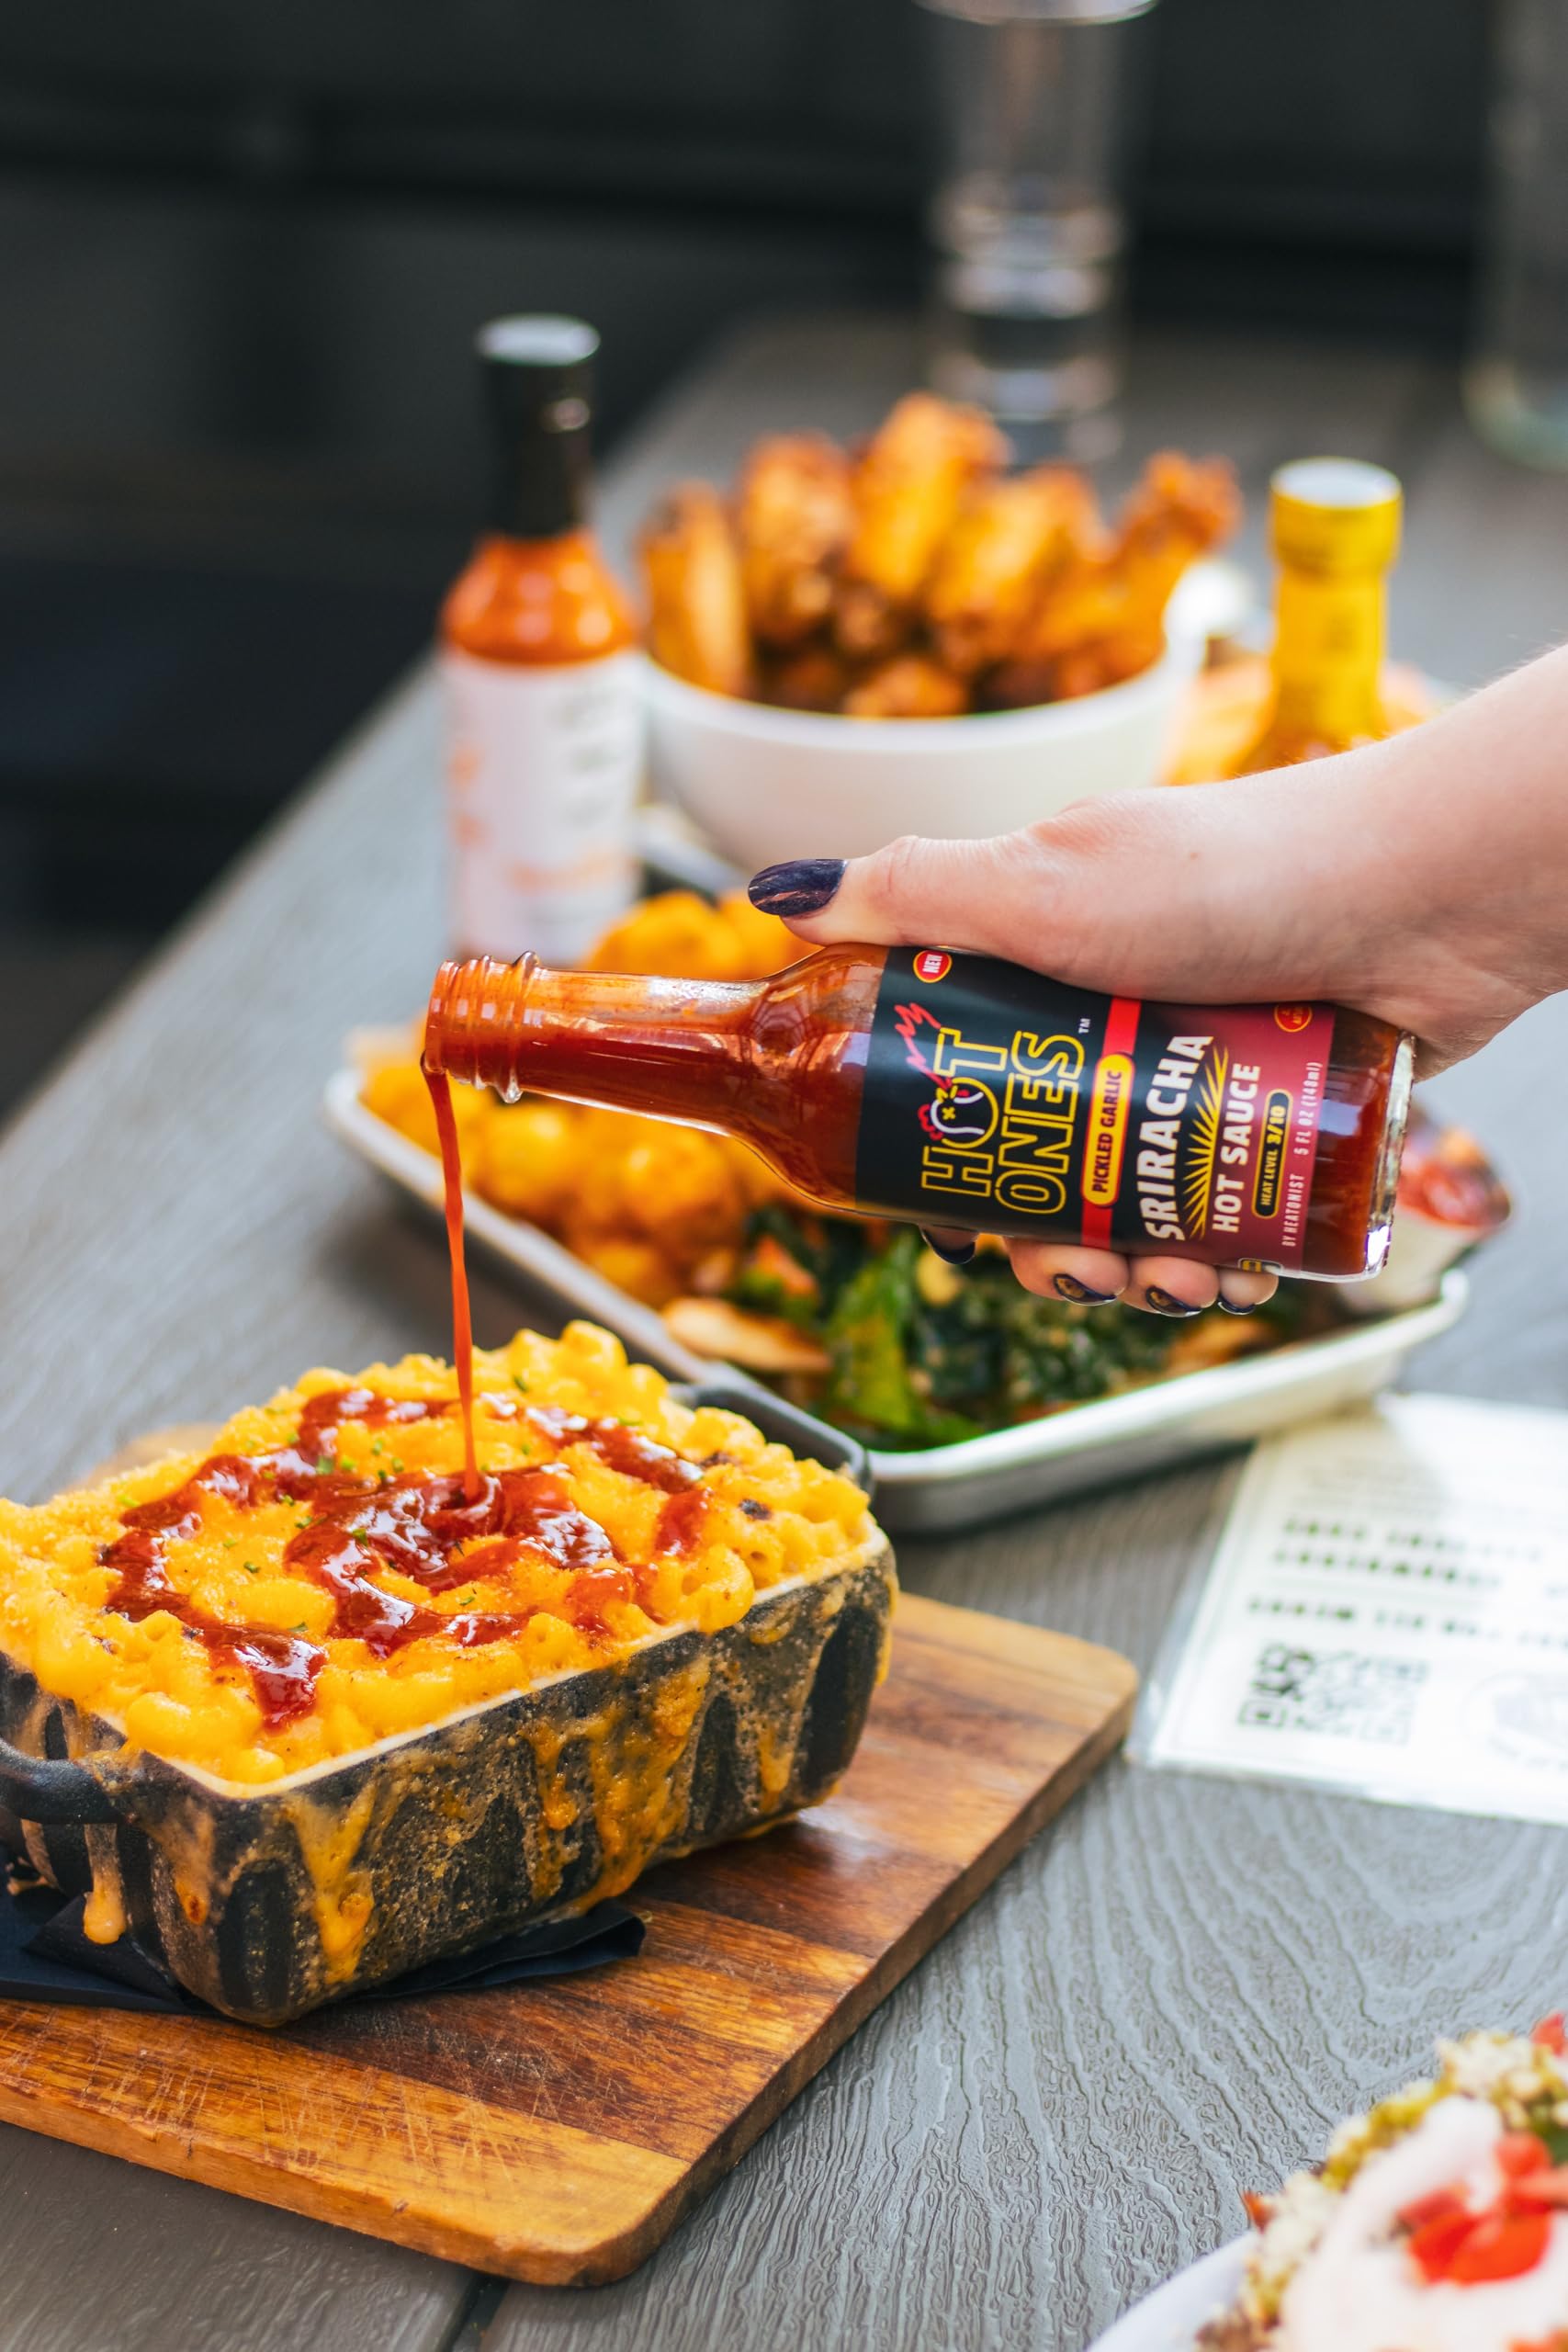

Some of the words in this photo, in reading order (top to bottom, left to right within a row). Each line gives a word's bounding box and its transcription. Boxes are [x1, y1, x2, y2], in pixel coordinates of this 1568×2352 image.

[922, 953, 943, 975] NEW
[920, 1026, 1009, 1198] HOT
[995, 1030, 1085, 1215] ONES
[1100, 1070, 1122, 1128] GARLIC
[1220, 1063, 1262, 1166] SAUCE
[1266, 1104, 1286, 1146] 3/10
[1298, 1111, 1314, 1126] OZ
[1091, 1133, 1114, 1193] PICKLED
[1136, 1035, 1214, 1241] SRIRACHA
[1263, 1148, 1279, 1180] LEVEL
[1295, 1130, 1313, 1143] FL
[1212, 1174, 1246, 1234] HOT
[1260, 1180, 1274, 1206] HEAT
[1282, 1173, 1305, 1233] HEATONIST
[1281, 1236, 1297, 1247] BY
